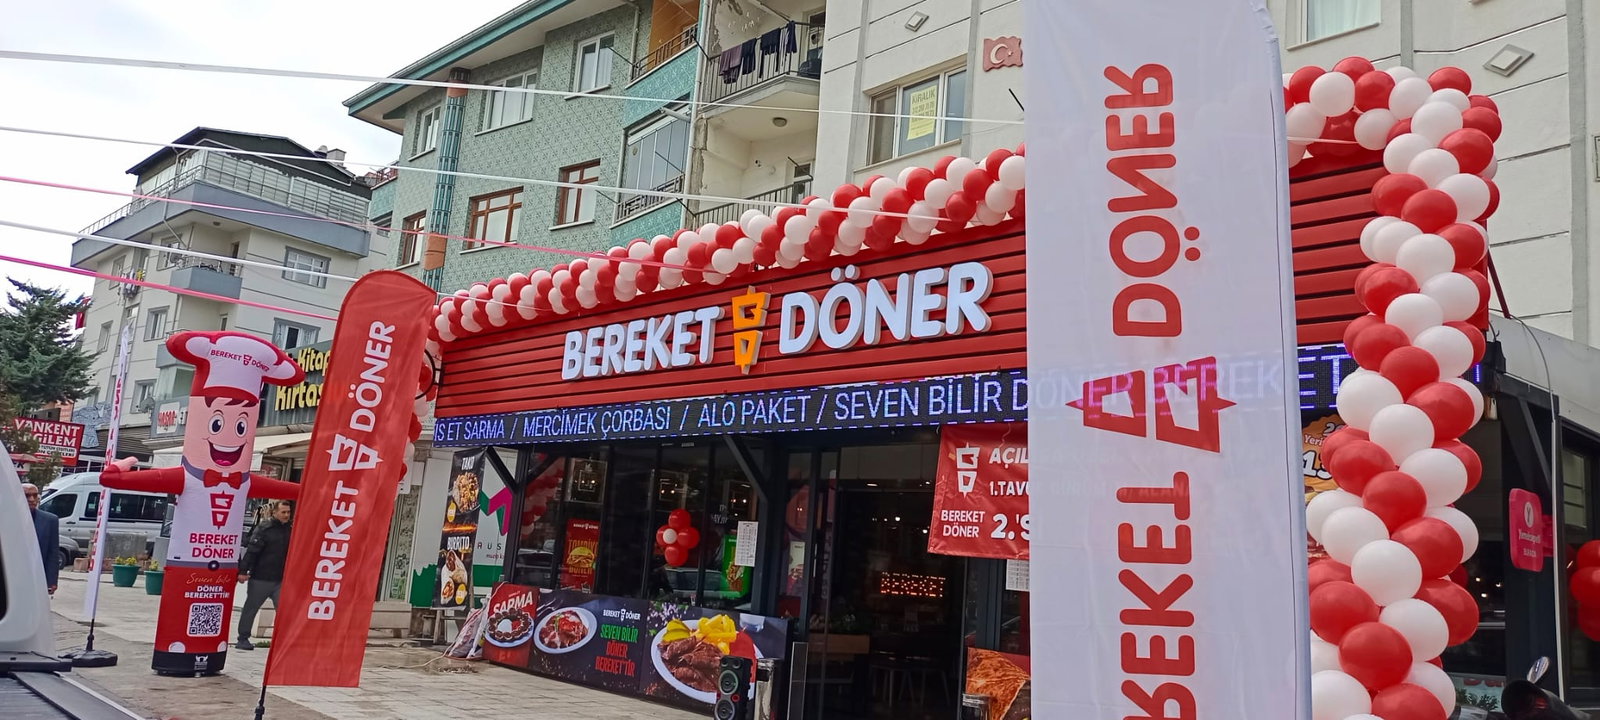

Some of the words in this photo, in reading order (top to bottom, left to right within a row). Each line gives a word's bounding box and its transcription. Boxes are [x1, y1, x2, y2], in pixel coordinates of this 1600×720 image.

[562, 306, 725, 380] BEREKET
[779, 261, 993, 354] DÖNER
[210, 349, 242, 361] BEREKET
[348, 320, 396, 433] DÖNER
[447, 422, 462, 440] ET
[464, 419, 505, 440] SARMA
[523, 409, 596, 437] MERCİMEK
[601, 406, 670, 438] ÇORBASI
[697, 402, 736, 427] ALO
[740, 395, 811, 425] PAKET
[834, 387, 919, 420] SEVEN
[928, 377, 1003, 415] BİLİR
[941, 510, 985, 523] BEREKET
[943, 522, 980, 538] DÖNER
[189, 533, 239, 545] BEREKET
[192, 545, 234, 559] DÖNER
[307, 479, 360, 621] BEREKET
[196, 584, 223, 593] DÖNER
[880, 571, 947, 598] BEREKET
[603, 609, 620, 618] BEREKET
[625, 609, 641, 620] DÖNER
[600, 624, 622, 640] SEVEN
[622, 625, 639, 643] BİLİR
